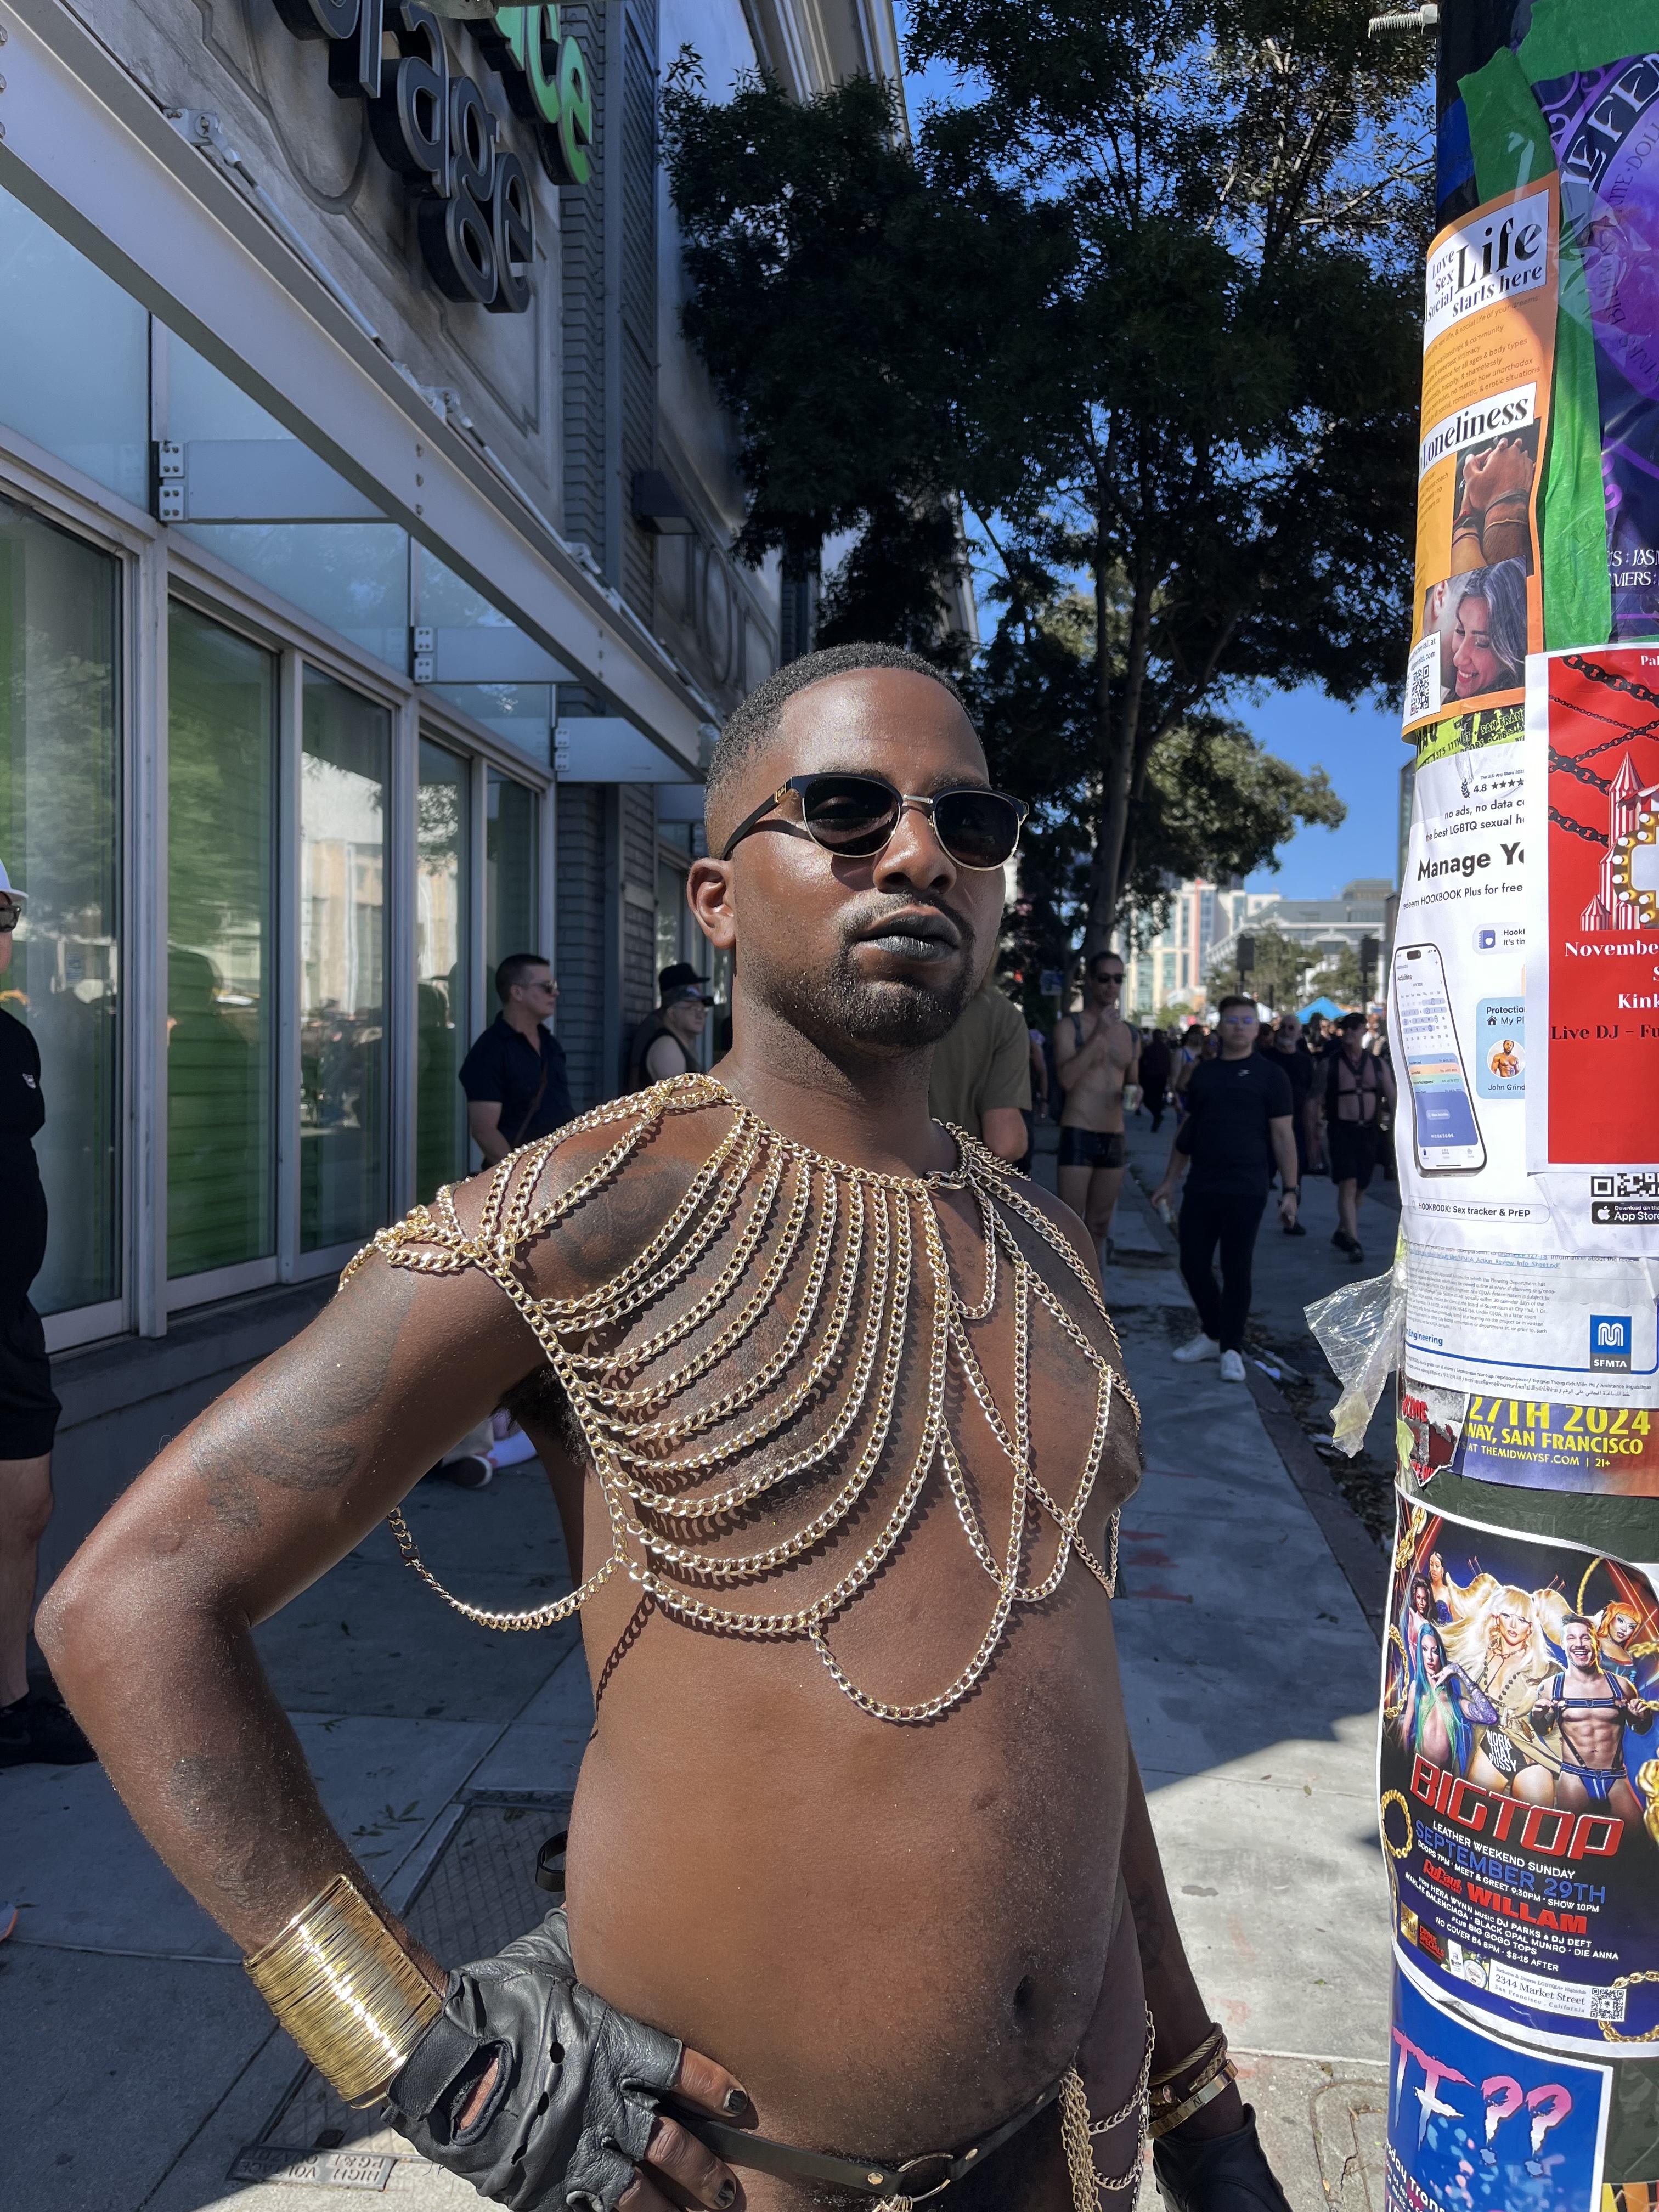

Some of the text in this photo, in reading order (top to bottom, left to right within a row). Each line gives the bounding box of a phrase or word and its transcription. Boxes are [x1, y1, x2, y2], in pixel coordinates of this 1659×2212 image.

[1432, 250, 1454, 280] Love
[1454, 217, 1542, 295] Life
[1435, 269, 1454, 295] sex
[1453, 266, 1542, 317] starts here
[1427, 285, 1453, 323] social
[1476, 315, 1486, 324] life
[1487, 309, 1494, 319] of
[1495, 304, 1511, 318] your
[1469, 324, 1504, 345] community
[1457, 345, 1481, 362] intimacy
[1469, 338, 1528, 366] ages body types
[1458, 358, 1533, 392] matter how unorthodox
[1465, 357, 1503, 377] shamelessly
[1452, 366, 1541, 405] romantic, erotic situations
[1422, 398, 1528, 470] Loneliness
[1481, 720, 1498, 735] SAN
[1448, 738, 1462, 752] 11TH
[1474, 783, 1487, 793] 4.8
[1444, 799, 1513, 819] no ads, no data
[1434, 815, 1512, 840] best LGBTQ sexual
[1417, 853, 1491, 881] Manage
[1420, 889, 1462, 906] HOOKBOOK
[1464, 886, 1482, 898] Plus
[1485, 884, 1499, 895] for
[1502, 882, 1523, 893] free
[1564, 940, 1659, 957] Novembe
[1500, 1016, 1514, 1026] My
[1551, 1024, 1659, 1040] Live DJ Fu
[1418, 1201, 1452, 1213] HOOKBOOK:
[1453, 1206, 1466, 1214] Sex
[1468, 1207, 1497, 1216] tracker
[1508, 1209, 1531, 1217] PrEP
[1614, 1211, 1635, 1222] App
[1408, 1328, 1443, 1347] Engineering
[1593, 1359, 1627, 1368] SFMTA
[1564, 1404, 1651, 1435] 2024
[1502, 1428, 1534, 1447] SAN
[1541, 1432, 1644, 1454] FRANCISCO
[1468, 1443, 1478, 1452] AT
[1481, 1445, 1579, 1466] THEMIDWAYSF.COM
[1595, 1458, 1611, 1468] 21+
[1486, 1729, 1513, 1749] WORK
[1489, 1752, 1517, 1772] PUSSY
[1490, 1744, 1511, 1762] THAT
[1409, 1752, 1626, 1860] BIGTOP
[1415, 1819, 1606, 1904] SEPTEMBER 29TH
[1432, 1820, 1576, 1880] LEATHER WEEKEND SUNDAY
[1418, 1839, 1600, 1913] DOORS 7PM MEET & GREET 9:30PM SHOW 10PM
[1405, 1871, 1425, 1894] MAHLAE
[1425, 1889, 1469, 1921] BALENCIAGA
[1474, 1917, 1503, 1936] BLACK
[1504, 1930, 1529, 1944] OPAL
[1531, 1938, 1566, 1954] MUNRO
[1573, 1948, 1591, 1957] DIE
[1592, 1950, 1619, 1960] ANNA
[1430, 1883, 1449, 1901] HERA
[1450, 1895, 1473, 1914] WYNN
[1474, 1909, 1495, 1923] MUSIC
[1496, 1917, 1509, 1928] DJ
[1511, 1922, 1542, 1938] PARKS
[1551, 1935, 1565, 1944] DJ
[1567, 1938, 1592, 1949] DEFT
[1467, 1881, 1588, 1934] WILLAM
[1435, 1916, 1446, 1927] NO
[1446, 1923, 1470, 1941] COVER
[1483, 1942, 1500, 1954] 8PM
[1531, 1958, 1559, 1972] AFTER
[1451, 1916, 1538, 1955] PLUS BIG GOGO TOPS
[1494, 1984, 1585, 2013] San Francisco California
[1495, 1974, 1586, 2006] 2344 Market Street
